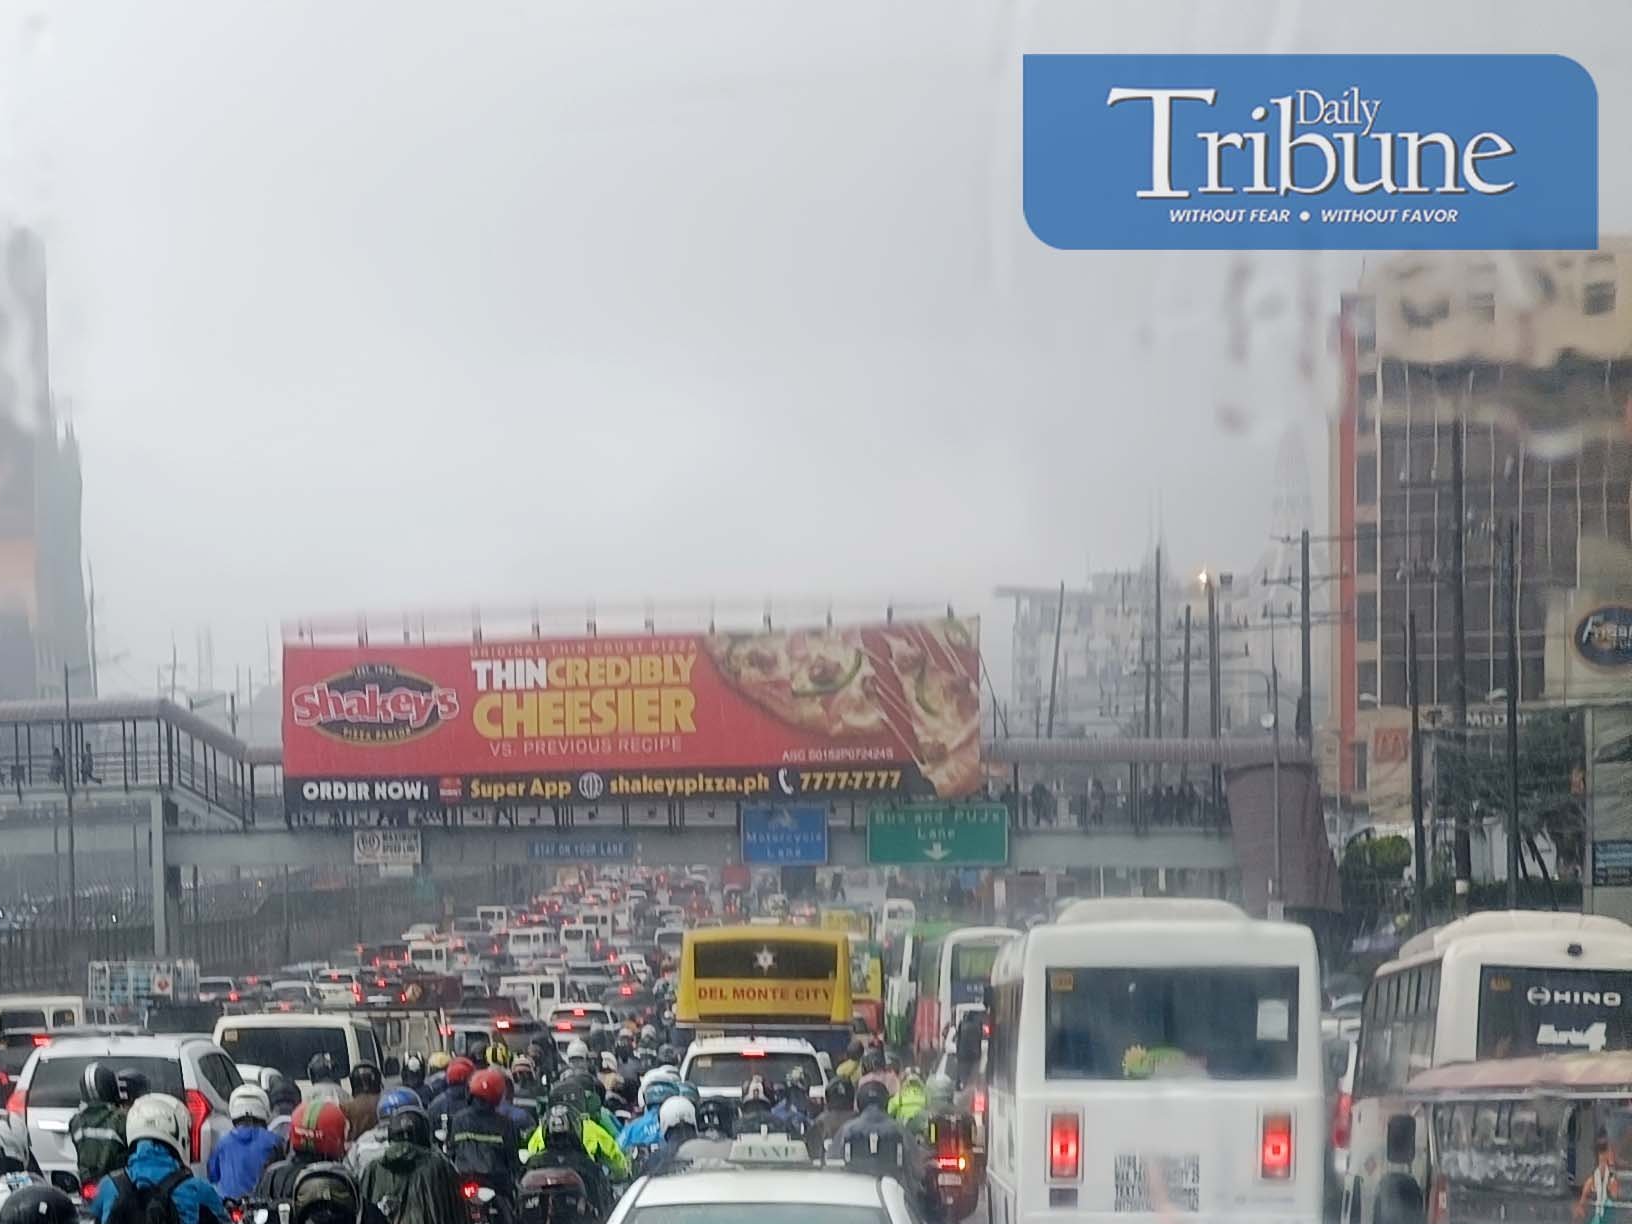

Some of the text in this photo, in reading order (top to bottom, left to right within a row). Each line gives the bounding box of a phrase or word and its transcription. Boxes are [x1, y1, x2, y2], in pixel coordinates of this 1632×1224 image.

[471, 653, 698, 692] THINCREDIBLY
[292, 682, 460, 729] Shakey's
[472, 687, 698, 740] CHEESIER
[523, 736, 613, 757] PREVIOUS
[618, 735, 683, 755] RECIPE
[302, 780, 370, 801] ORDER
[470, 778, 525, 801] Super
[530, 776, 572, 800] App
[609, 771, 770, 797] shakeyspizza.ph
[917, 810, 944, 825] and
[917, 826, 957, 840] Lane
[767, 846, 802, 859] Lane
[697, 986, 833, 1001] DEL MONTE CITY
[1553, 989, 1622, 1007] HINO
